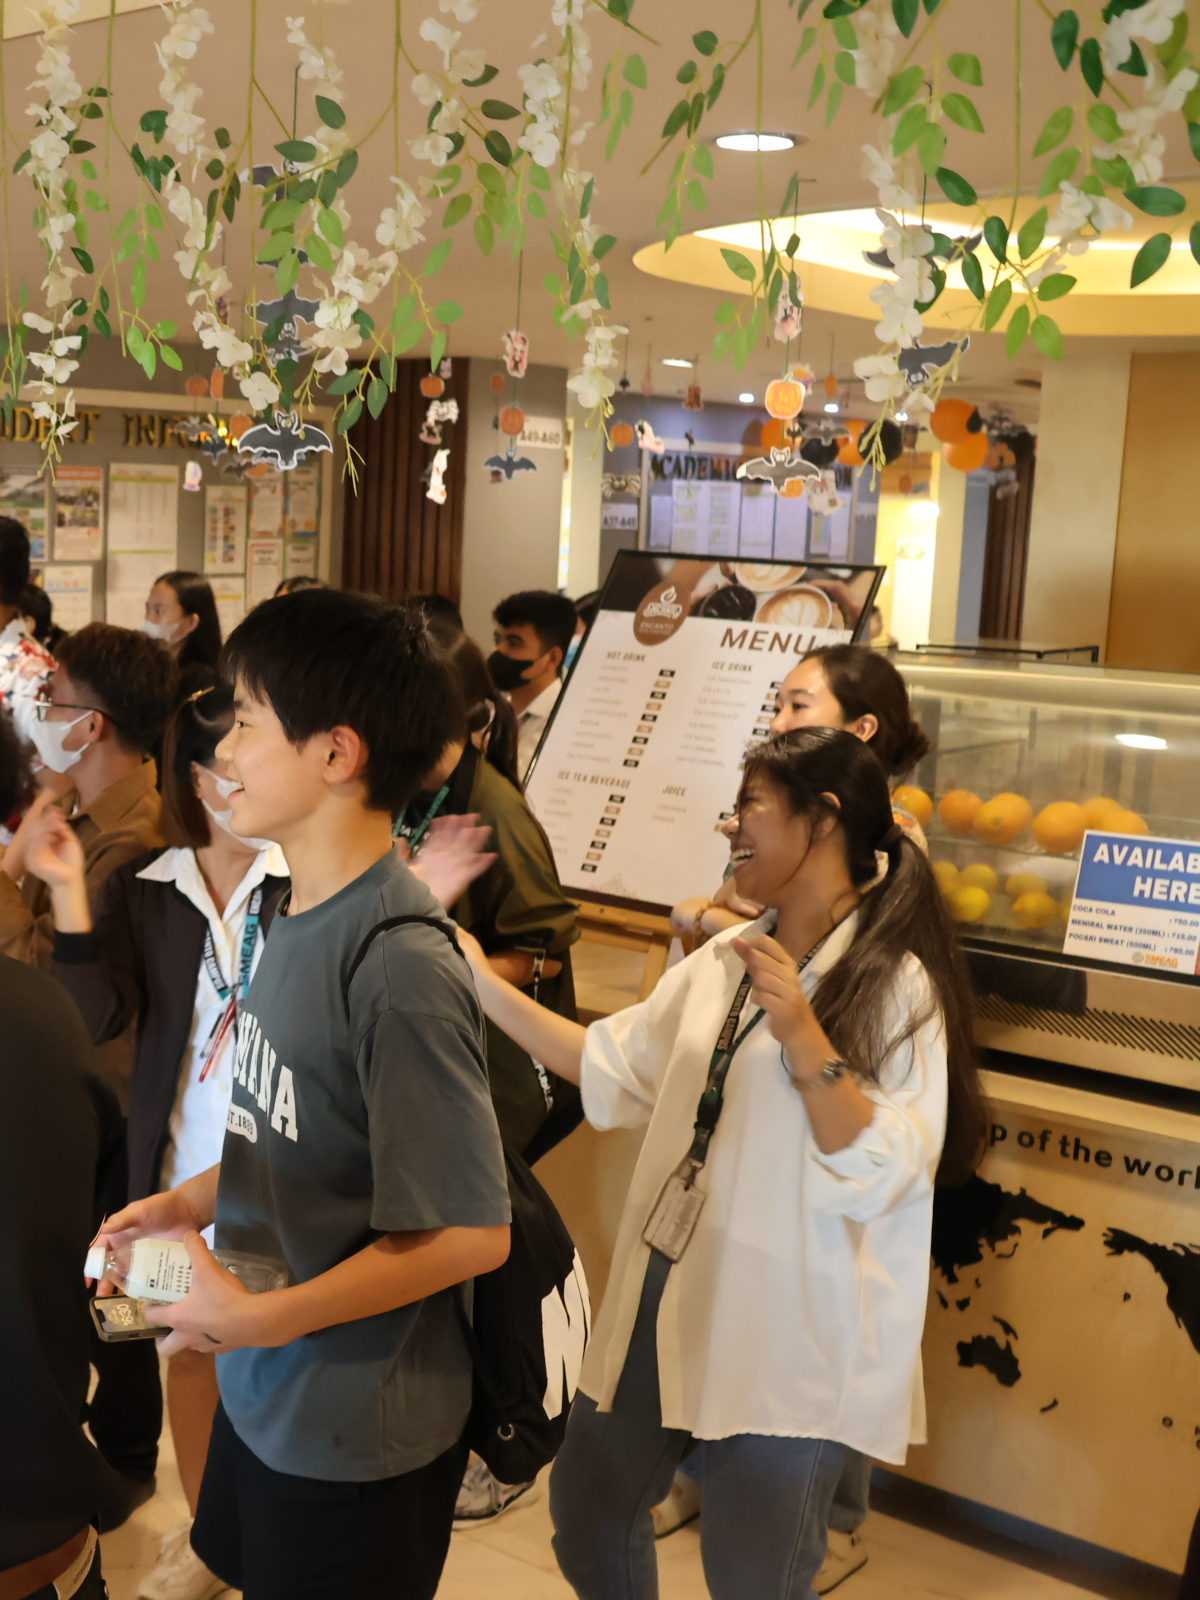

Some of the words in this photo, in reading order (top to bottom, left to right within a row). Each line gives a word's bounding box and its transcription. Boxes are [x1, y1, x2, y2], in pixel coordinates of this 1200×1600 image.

[720, 627, 817, 656] MENU
[623, 653, 646, 662] DRINK
[711, 661, 726, 671] ICE
[727, 663, 753, 673] DRINK
[557, 770, 571, 780] ICE
[573, 773, 588, 783] TEA
[590, 775, 631, 789] BEVERAGE
[662, 785, 687, 796] JUICE
[1133, 875, 1200, 906] HERE
[1073, 905, 1093, 913] COCA
[1096, 908, 1116, 916] COLA
[1071, 918, 1105, 930] MENIRAL
[1106, 924, 1134, 933] WATER
[1068, 932, 1097, 943] POCARI
[1098, 936, 1125, 946] SWEAT
[1145, 953, 1179, 967] SMEAG
[1016, 1129, 1052, 1152] of
[1058, 1134, 1113, 1168] the
